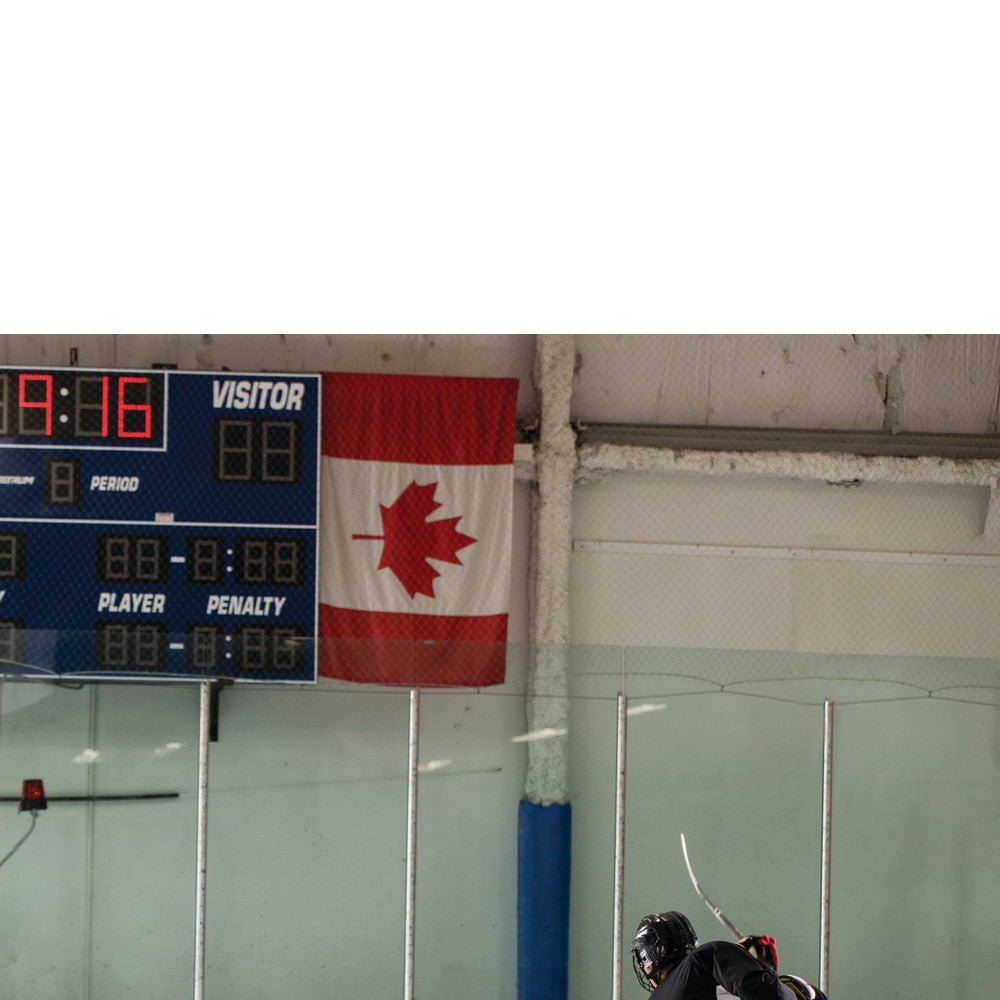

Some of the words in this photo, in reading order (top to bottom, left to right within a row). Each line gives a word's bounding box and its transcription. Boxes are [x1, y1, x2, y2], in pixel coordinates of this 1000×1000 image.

[18, 374, 152, 439] 9:16
[212, 380, 306, 411] VISITOR
[90, 475, 140, 492] PERIOD
[97, 592, 167, 614] PLAYER
[206, 595, 287, 616] PENALTY
